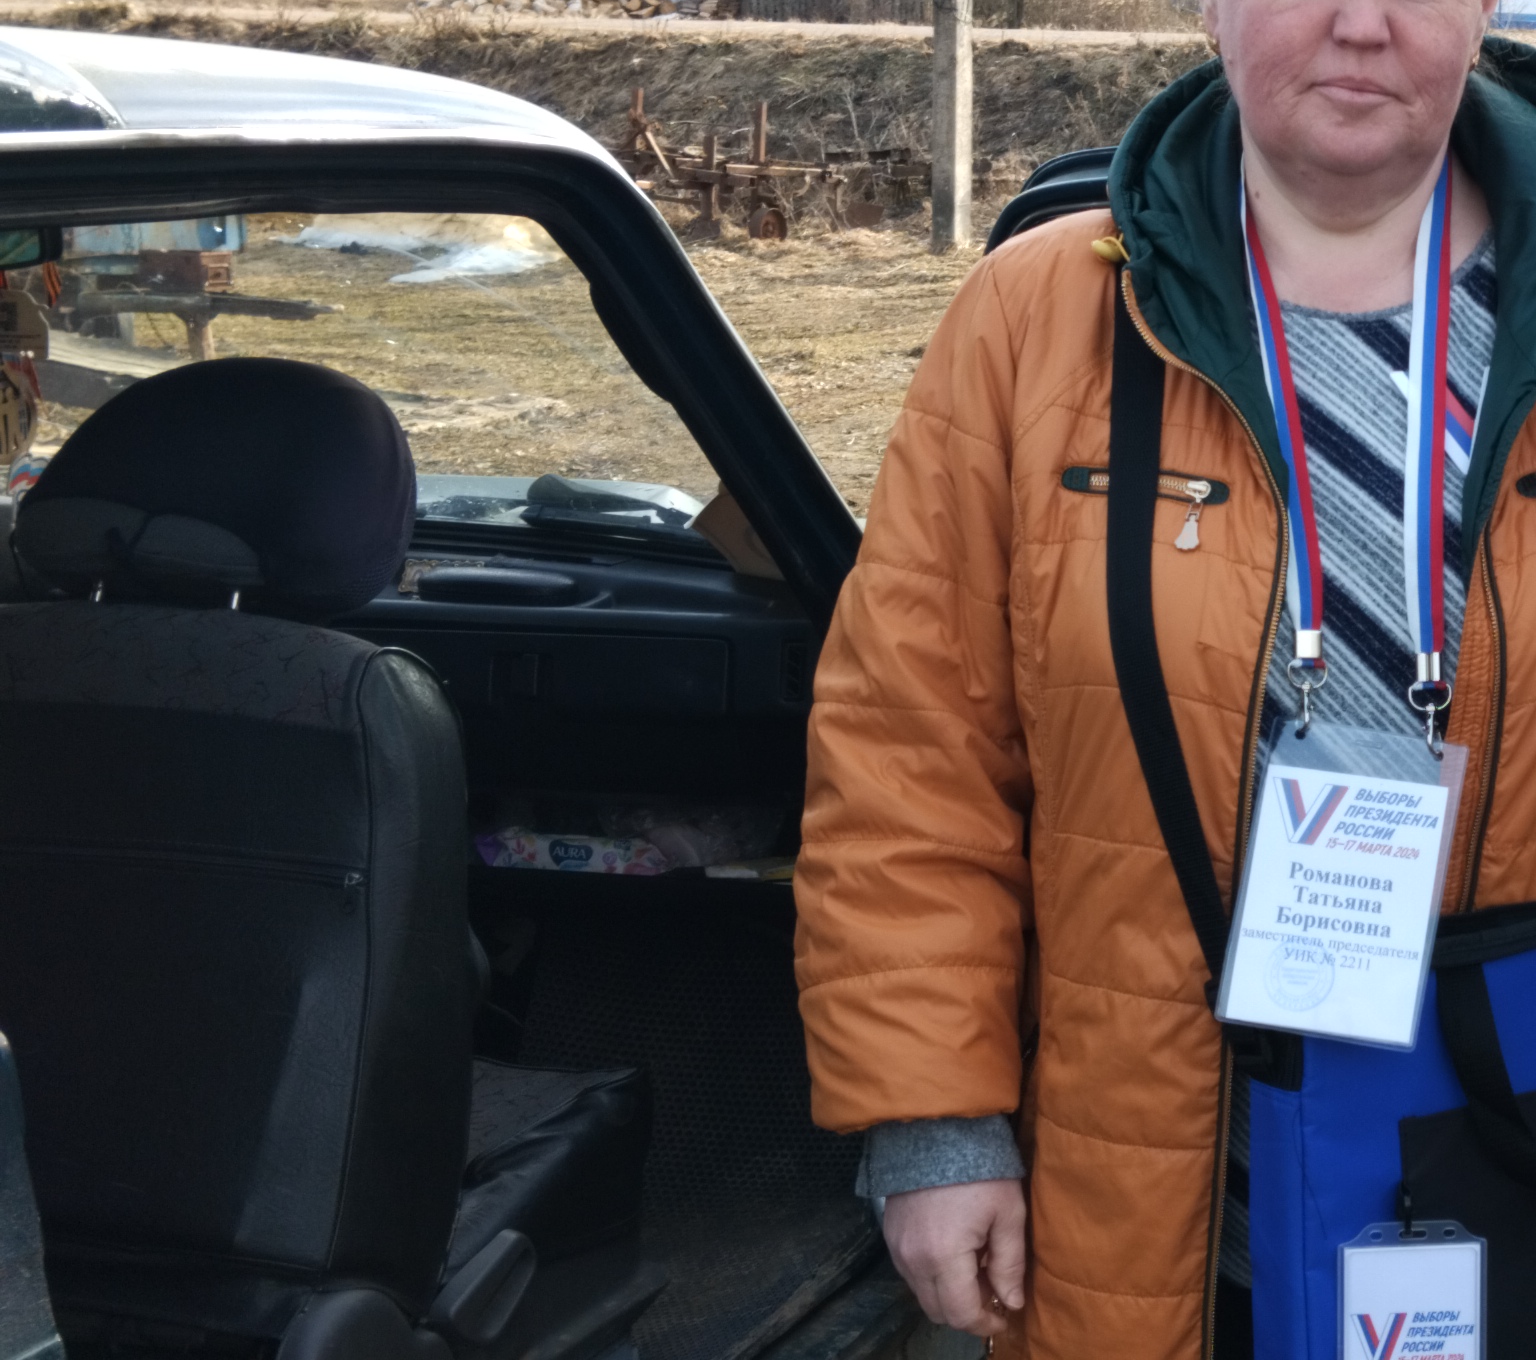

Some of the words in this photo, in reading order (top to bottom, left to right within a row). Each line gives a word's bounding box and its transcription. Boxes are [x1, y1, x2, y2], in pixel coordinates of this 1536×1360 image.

[1354, 788, 1422, 809] ВЫБОРЫ
[1344, 805, 1439, 830] ПРЕЗИДЕНТА
[1333, 822, 1396, 841] РОССИИ
[553, 846, 586, 859] AURA
[1355, 841, 1393, 857] МАРТА
[1393, 845, 1420, 860] 2024
[1288, 861, 1393, 892] Романова
[1292, 885, 1383, 914] Татьяна
[1275, 905, 1392, 938] Борисовна
[1242, 927, 1324, 948] заместитель
[1328, 936, 1419, 961] председателя
[1283, 946, 1317, 964] УИК
[1339, 954, 1371, 971] 2211
[1412, 1311, 1460, 1323] ВЫБОРЫ
[1407, 1324, 1474, 1338] ПРЕЗИДЕНТА
[1401, 1340, 1445, 1352] РОССИИ
